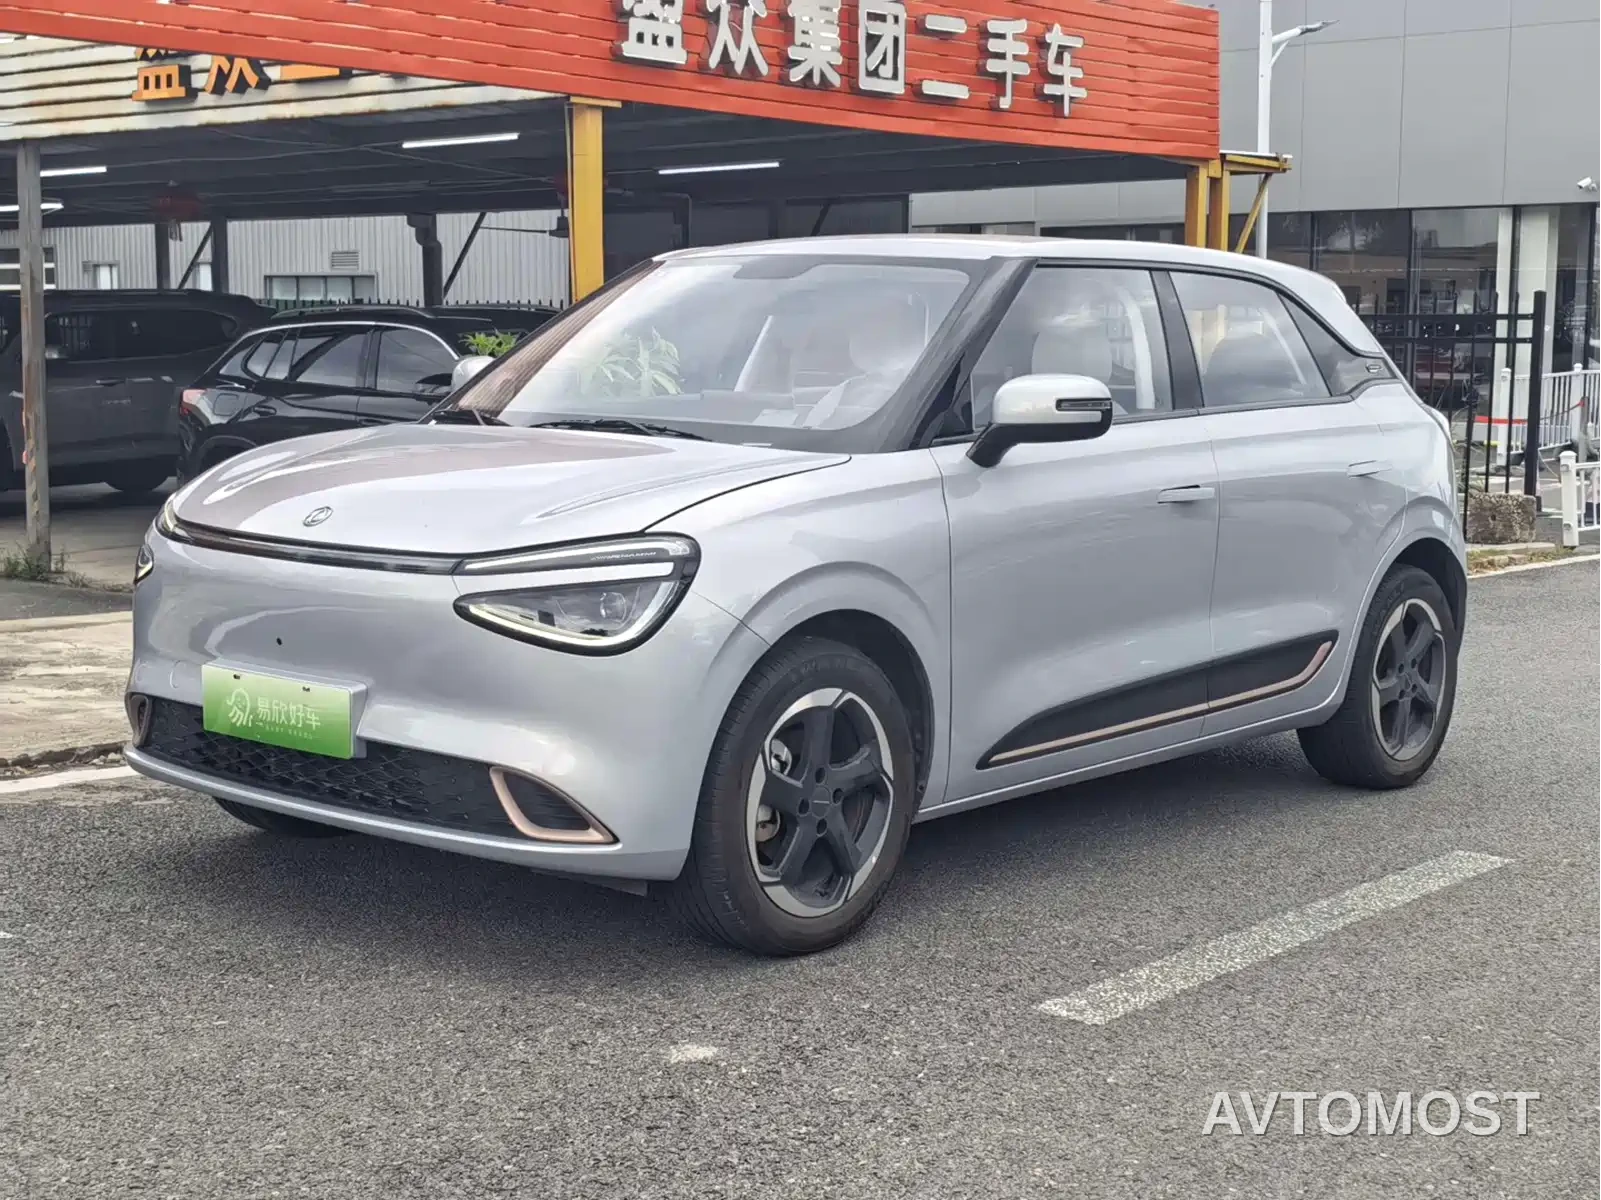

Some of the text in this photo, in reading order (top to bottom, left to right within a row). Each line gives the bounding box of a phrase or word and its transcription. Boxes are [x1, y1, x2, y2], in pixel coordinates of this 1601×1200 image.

[619, 0, 1088, 117] 盈众集团二手车
[256, 695, 321, 731] 易欣好车
